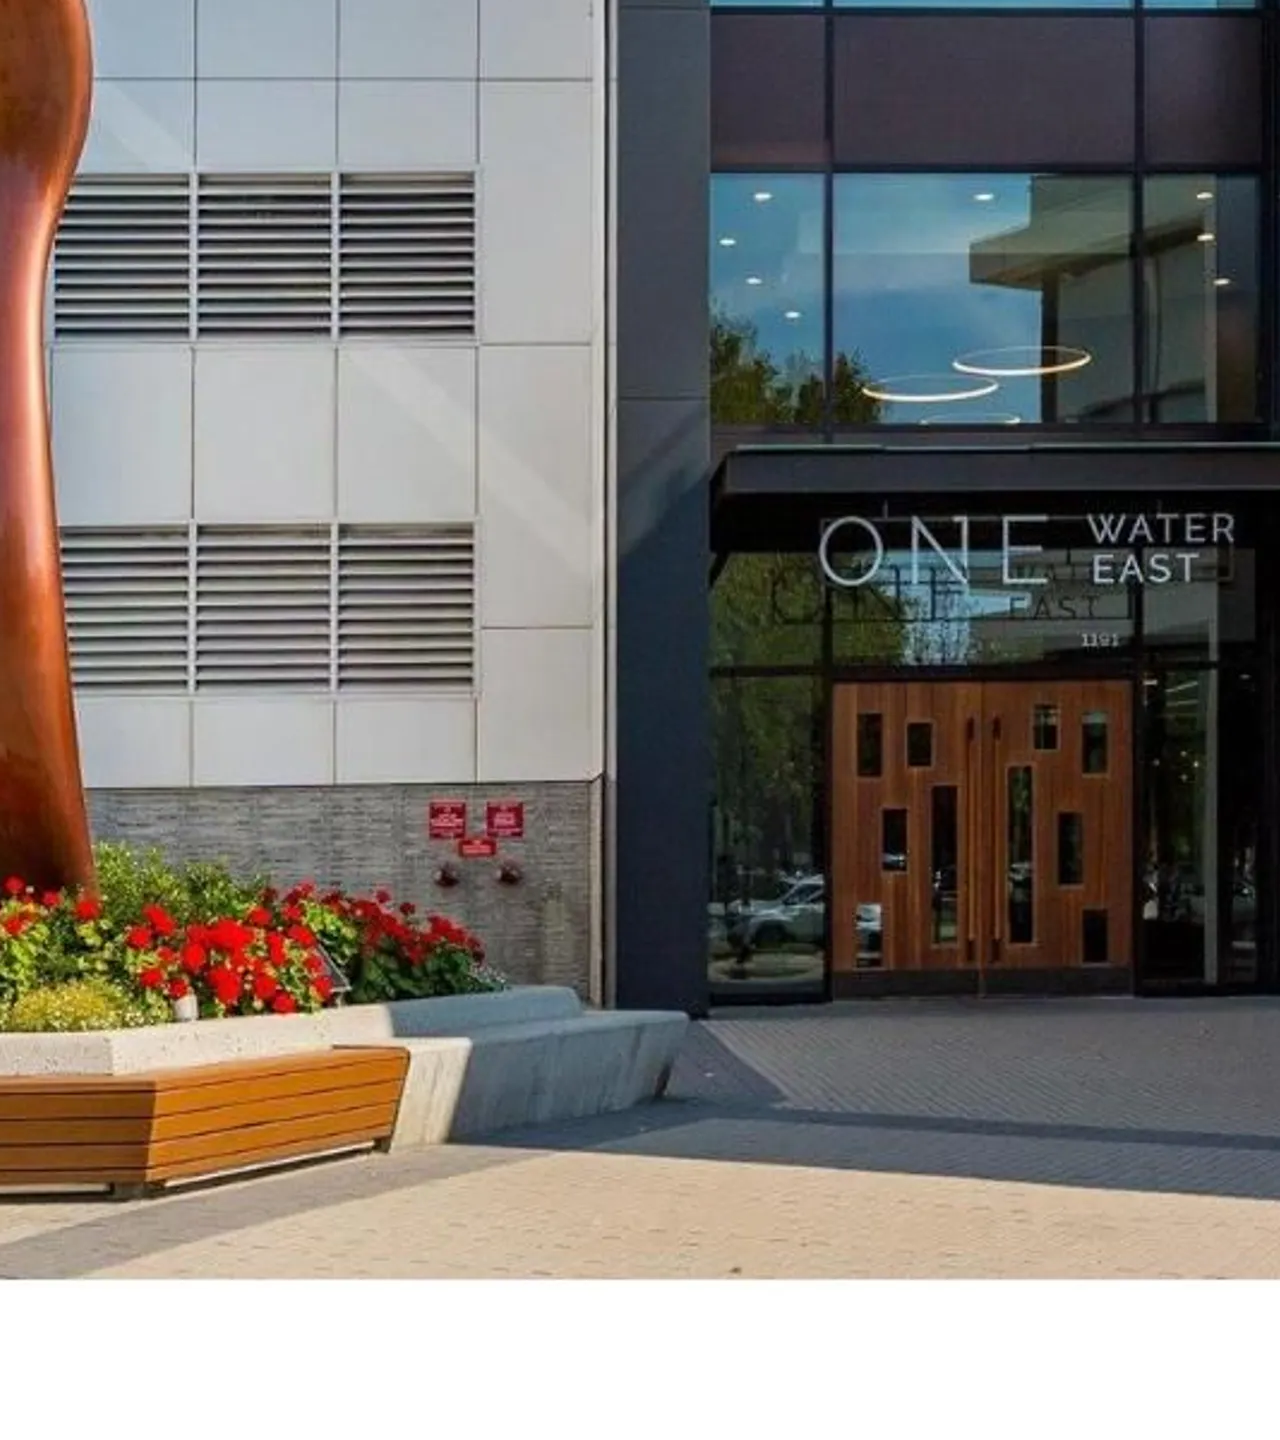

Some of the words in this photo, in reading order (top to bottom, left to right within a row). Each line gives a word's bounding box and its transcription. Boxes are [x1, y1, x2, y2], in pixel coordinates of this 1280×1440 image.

[819, 515, 1048, 587] ONE
[1086, 513, 1236, 544] WATER
[1092, 553, 1200, 585] EAST
